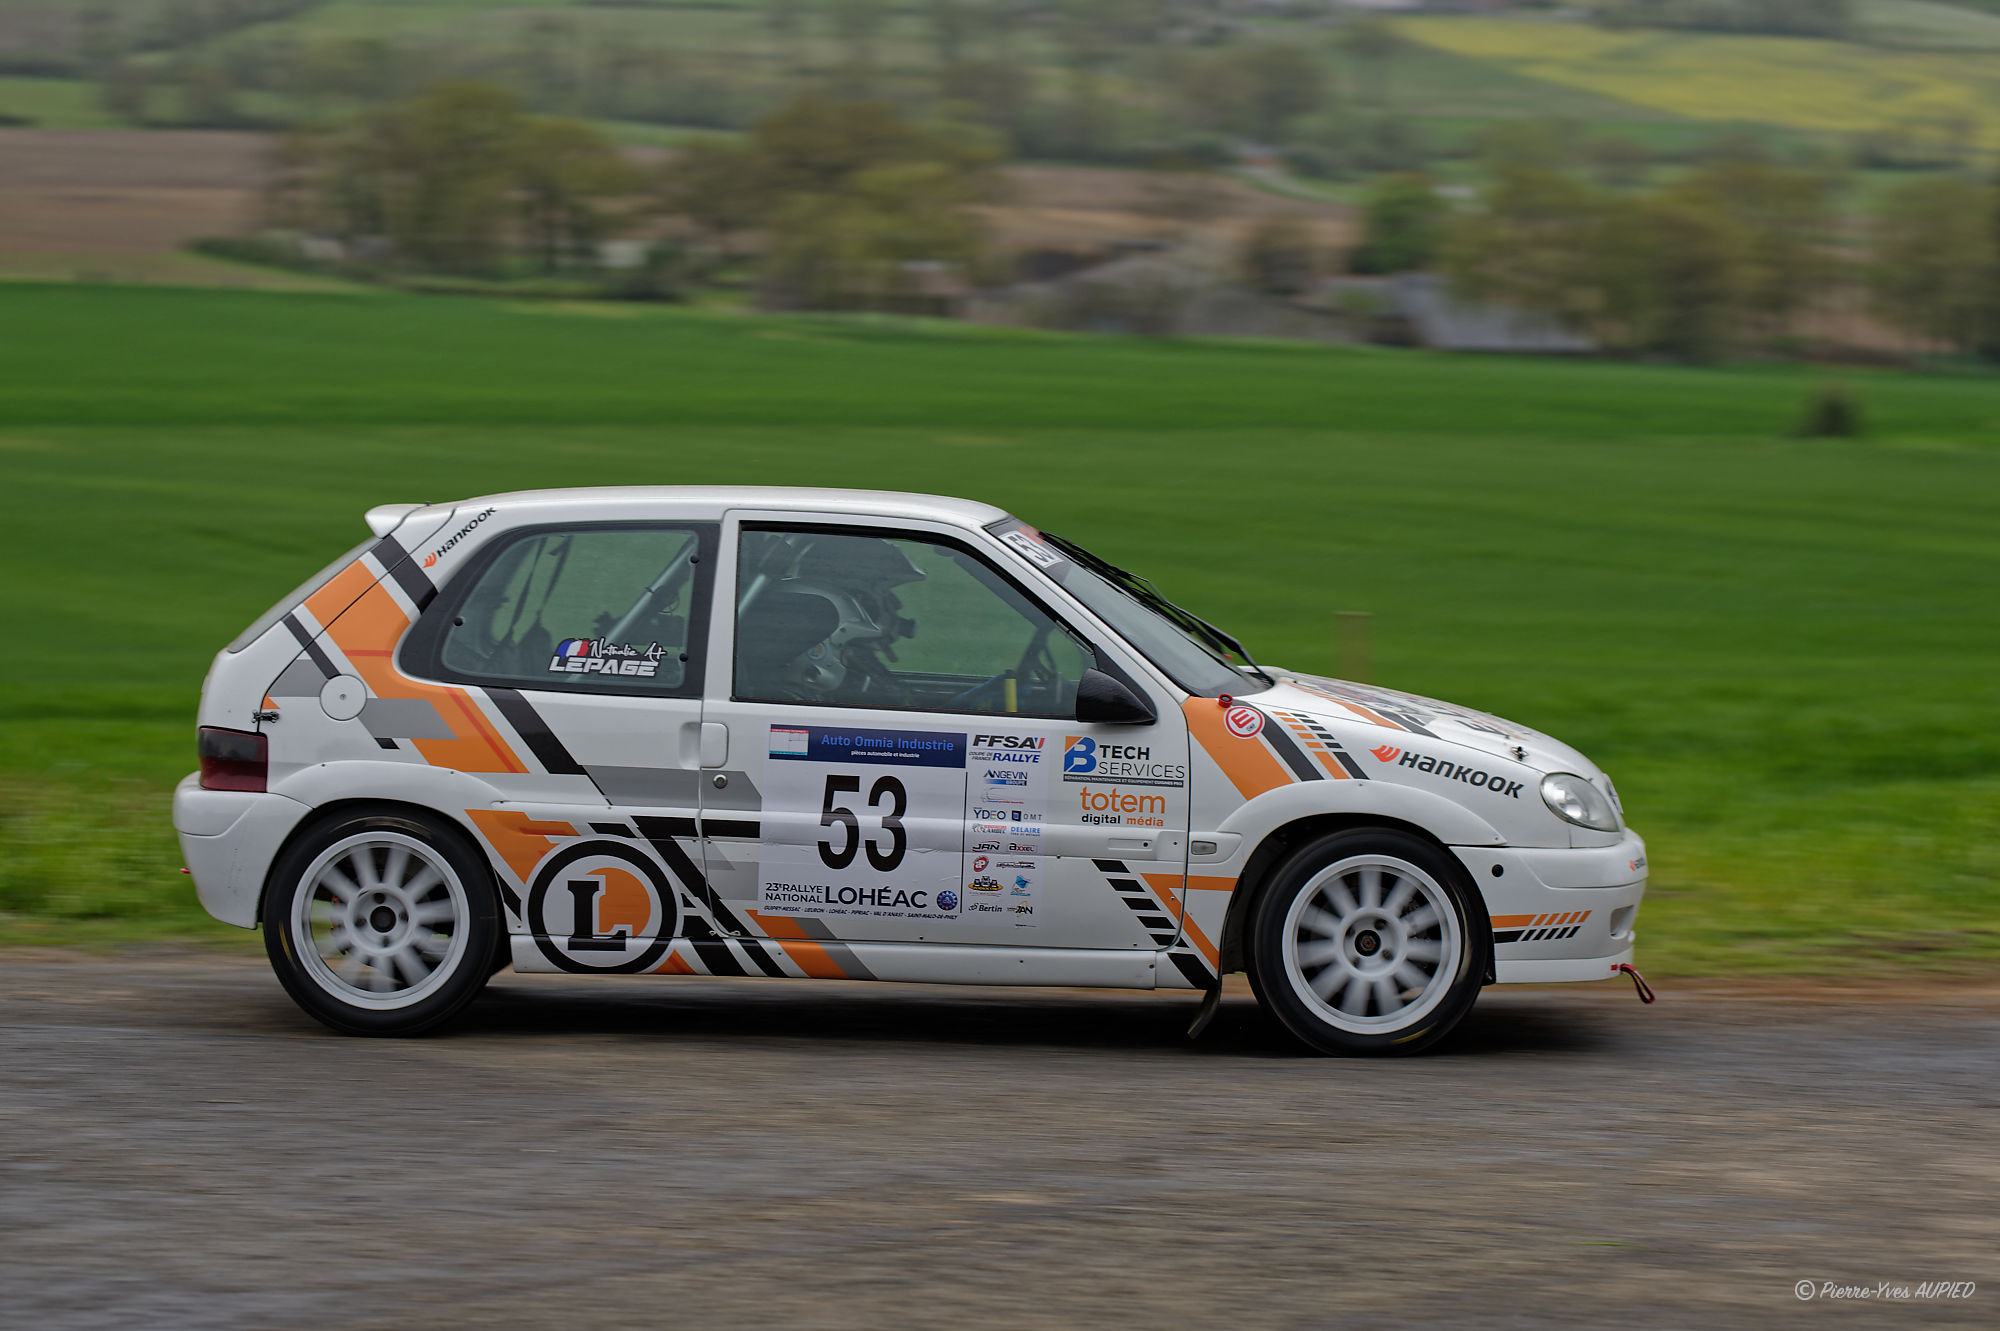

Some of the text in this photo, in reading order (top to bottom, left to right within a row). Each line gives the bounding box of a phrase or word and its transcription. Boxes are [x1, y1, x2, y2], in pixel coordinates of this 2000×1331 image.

[549, 656, 659, 677] LEPAGE
[821, 733, 954, 751] Auto Omnia Industrie
[973, 734, 1036, 749] FFSA
[992, 752, 1041, 763] RALLYE
[1099, 744, 1150, 760] TECH
[983, 769, 1028, 780] ANGEVIN
[1098, 761, 1185, 779] SERVICES
[1080, 786, 1165, 814] totem
[973, 809, 1006, 820] YDEO
[1081, 813, 1163, 826] digital média
[817, 774, 907, 872] 53
[765, 892, 823, 904] NATIONAL
[825, 885, 928, 909] LOHÉAC
[567, 880, 627, 952] L
[978, 904, 1003, 912] Bertin
